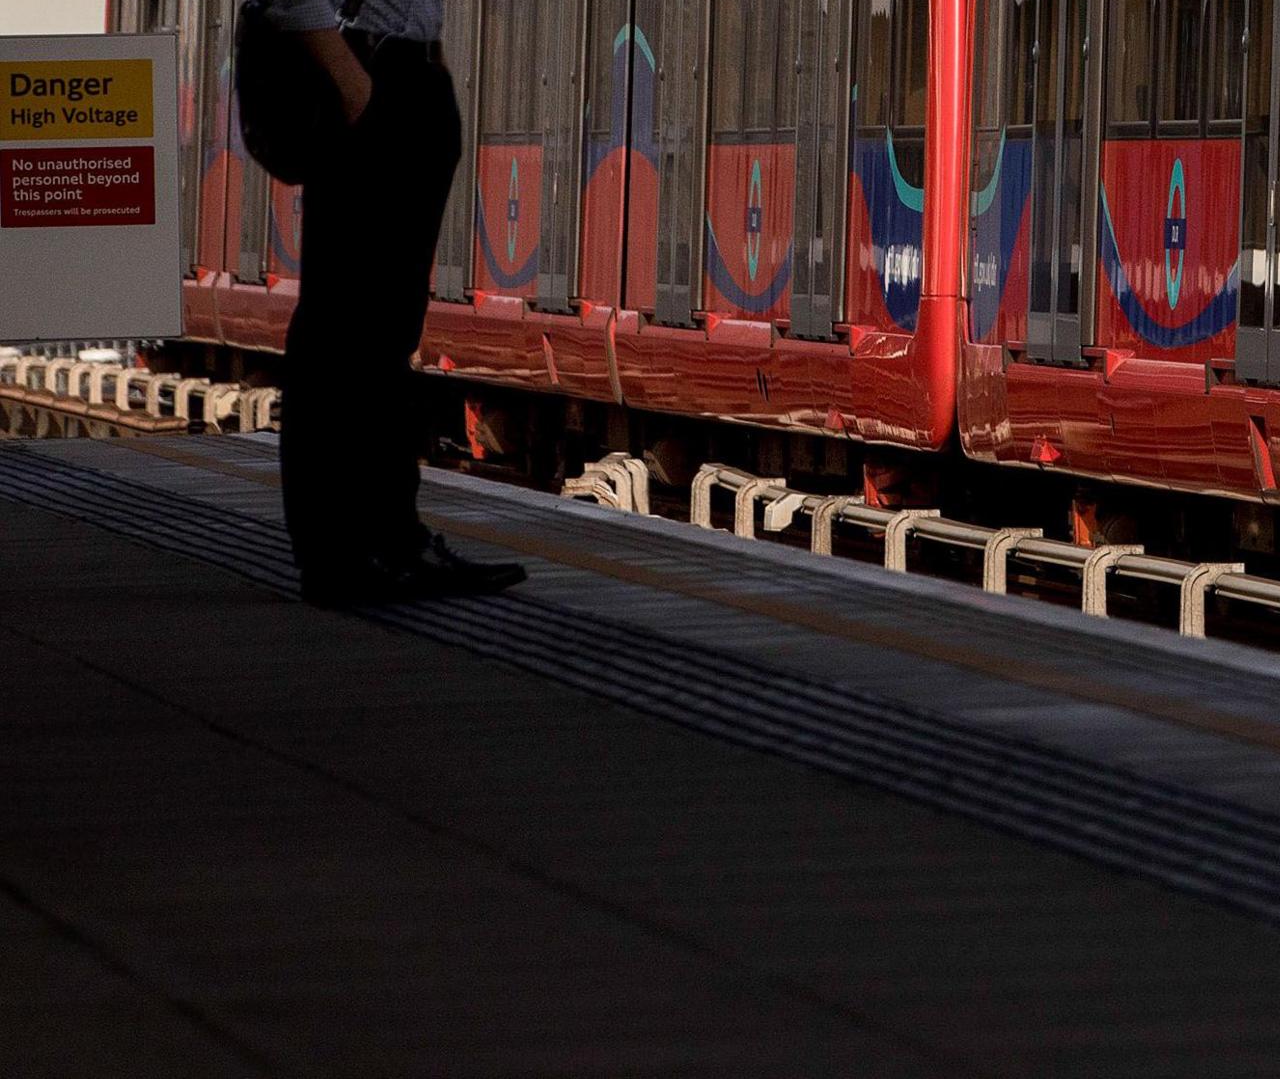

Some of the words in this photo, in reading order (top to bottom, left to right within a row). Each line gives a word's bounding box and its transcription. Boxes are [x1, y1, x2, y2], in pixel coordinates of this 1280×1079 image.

[10, 73, 113, 101] Danger
[11, 108, 55, 128] High
[62, 106, 138, 126] Voltage
[12, 159, 33, 171] No
[38, 157, 131, 170] unauthorised
[13, 173, 83, 189] personnel
[88, 172, 140, 187] beyond
[13, 189, 41, 201] this
[45, 188, 83, 203] point
[14, 208, 62, 217] Trespassers
[64, 207, 79, 215] will
[81, 207, 91, 215] be
[93, 206, 140, 216] prosecuted
